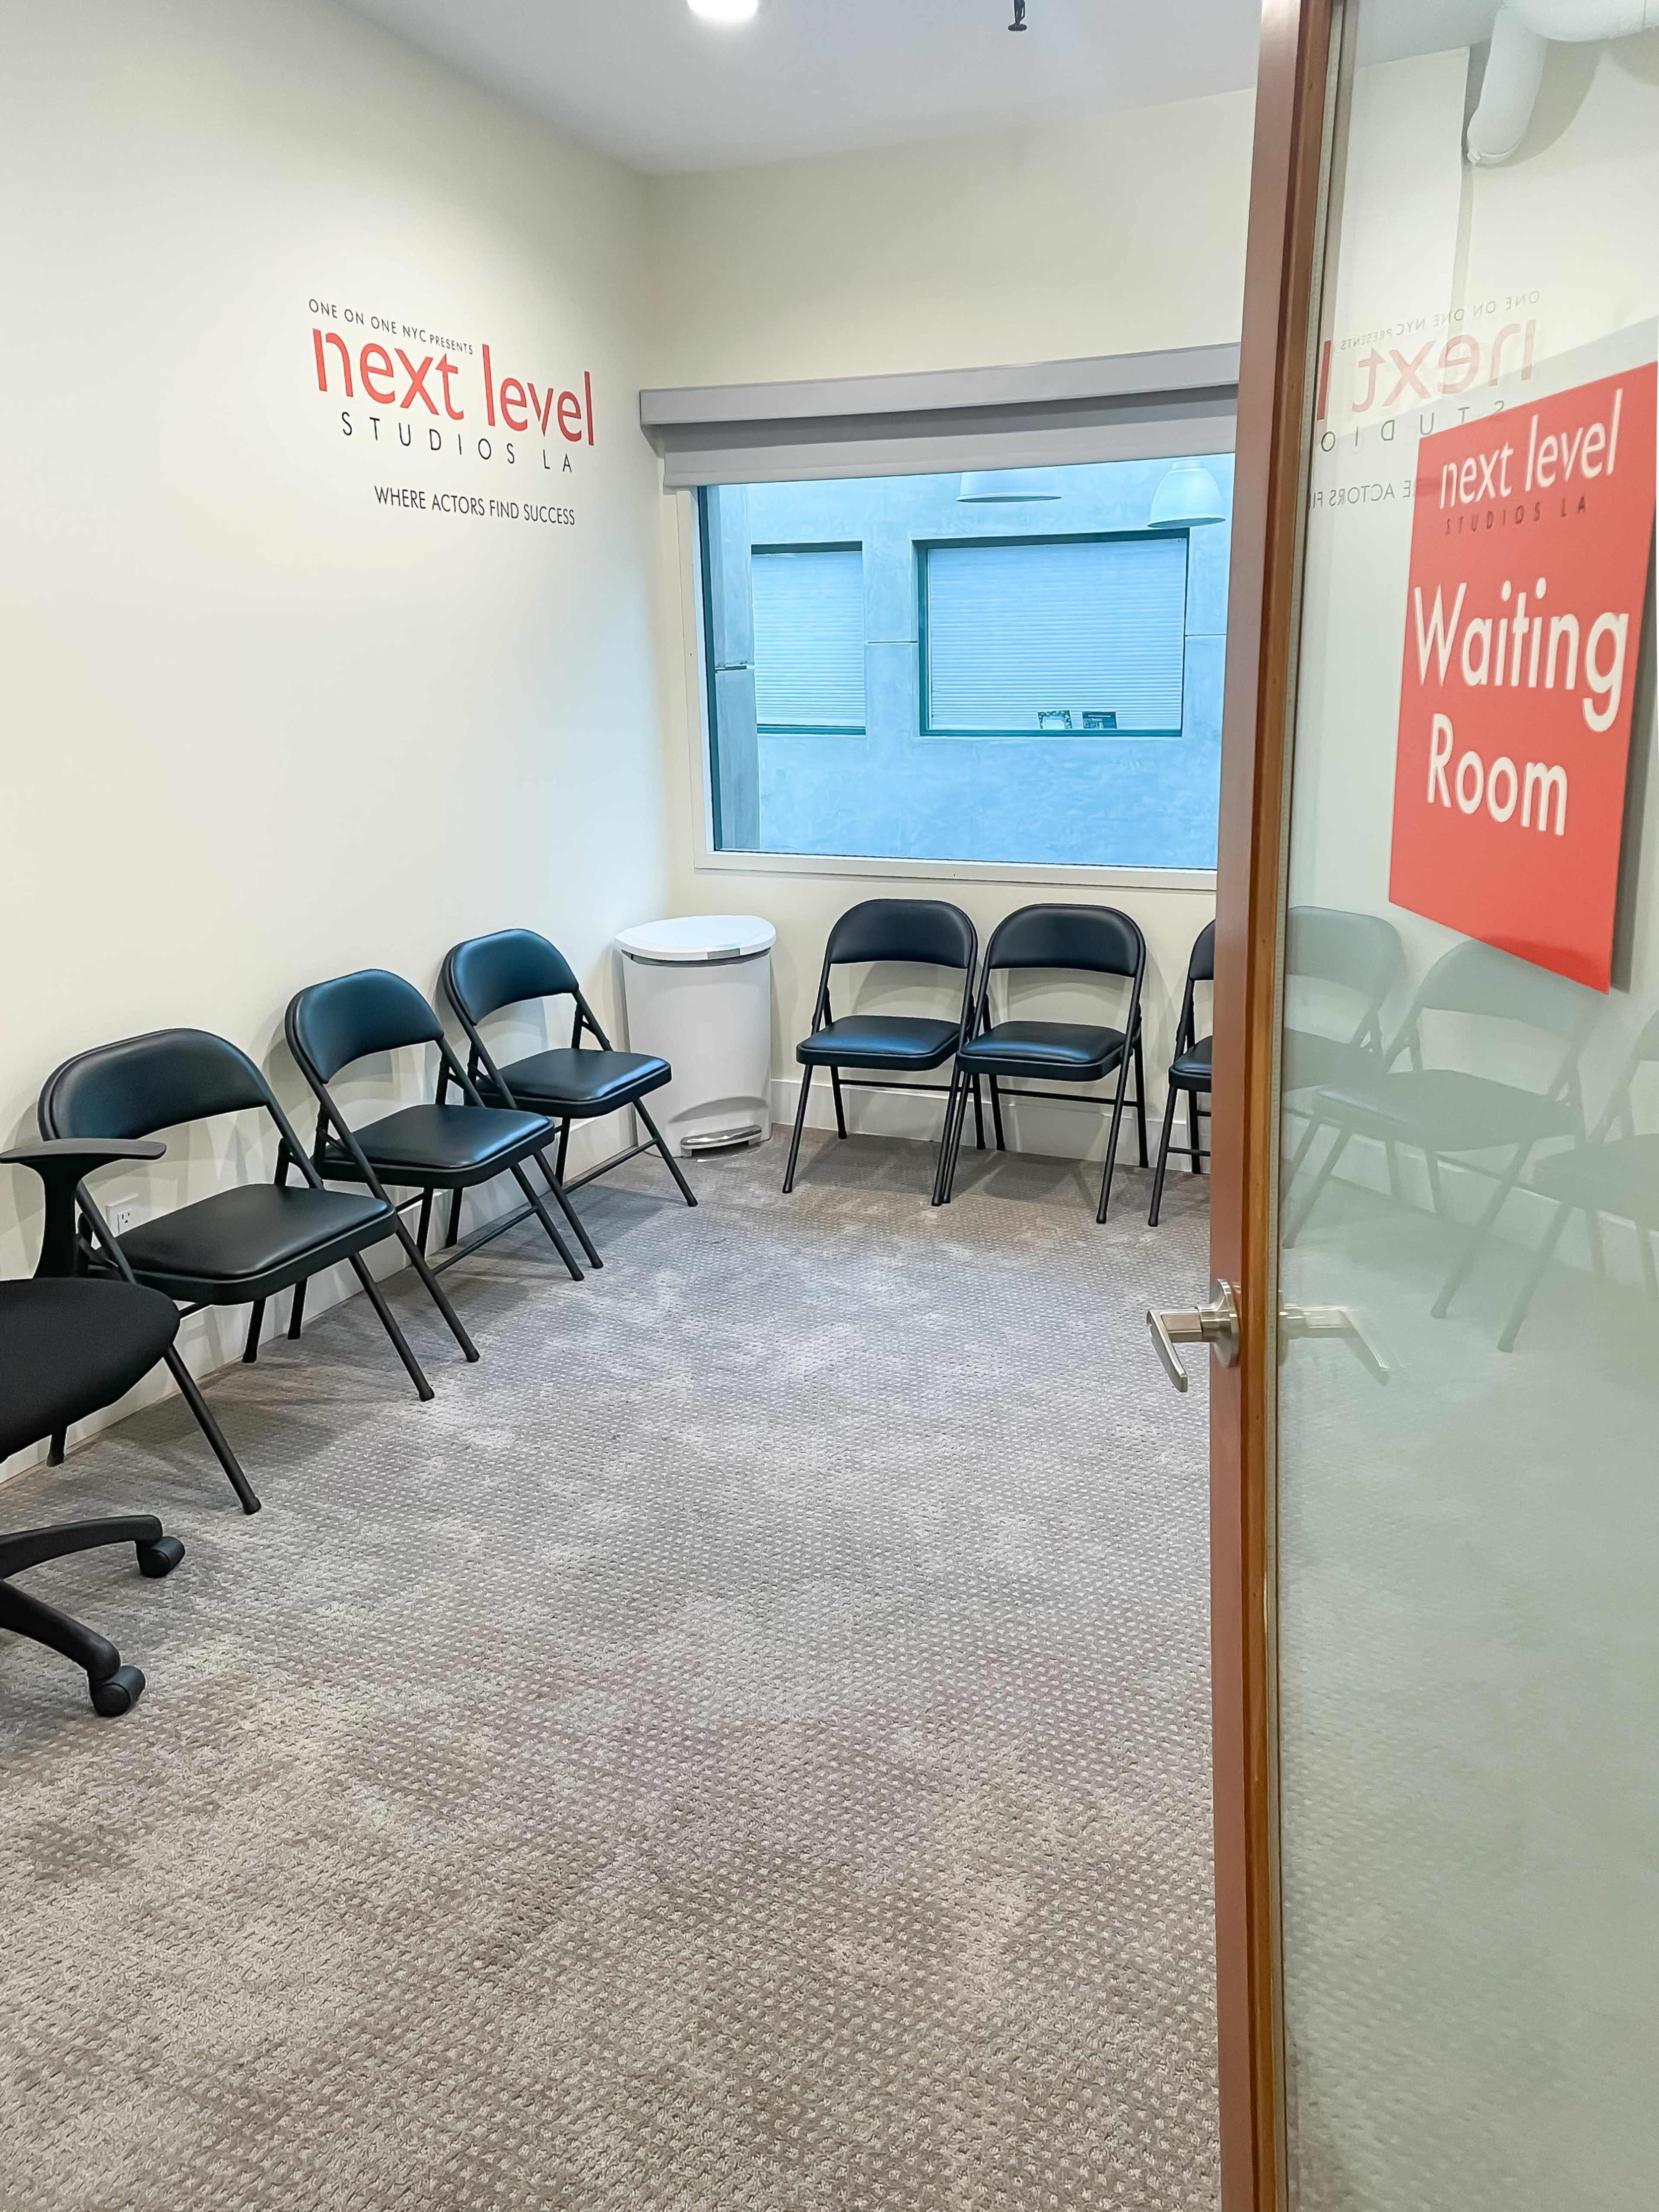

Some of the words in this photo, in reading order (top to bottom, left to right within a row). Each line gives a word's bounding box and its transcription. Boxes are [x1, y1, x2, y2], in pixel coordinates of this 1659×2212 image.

[309, 299, 337, 318] ONE
[344, 309, 364, 325] ON
[371, 317, 397, 334] ONE
[403, 325, 426, 342] NYC
[430, 334, 473, 355] PRESENTS
[313, 328, 464, 420] next
[482, 344, 594, 446] level
[342, 412, 515, 464] STUDIOS
[543, 449, 572, 473] LA
[1440, 442, 1514, 509] next
[1525, 388, 1623, 492] level
[374, 486, 426, 509] WHERE
[432, 493, 484, 515] ACTORS
[490, 500, 518, 519] FIND
[524, 504, 575, 525] SUCCESS
[1445, 502, 1541, 536] STUDIOS
[1561, 496, 1586, 517] LA
[1414, 577, 1629, 732] Waiting
[1427, 713, 1567, 836] Room
